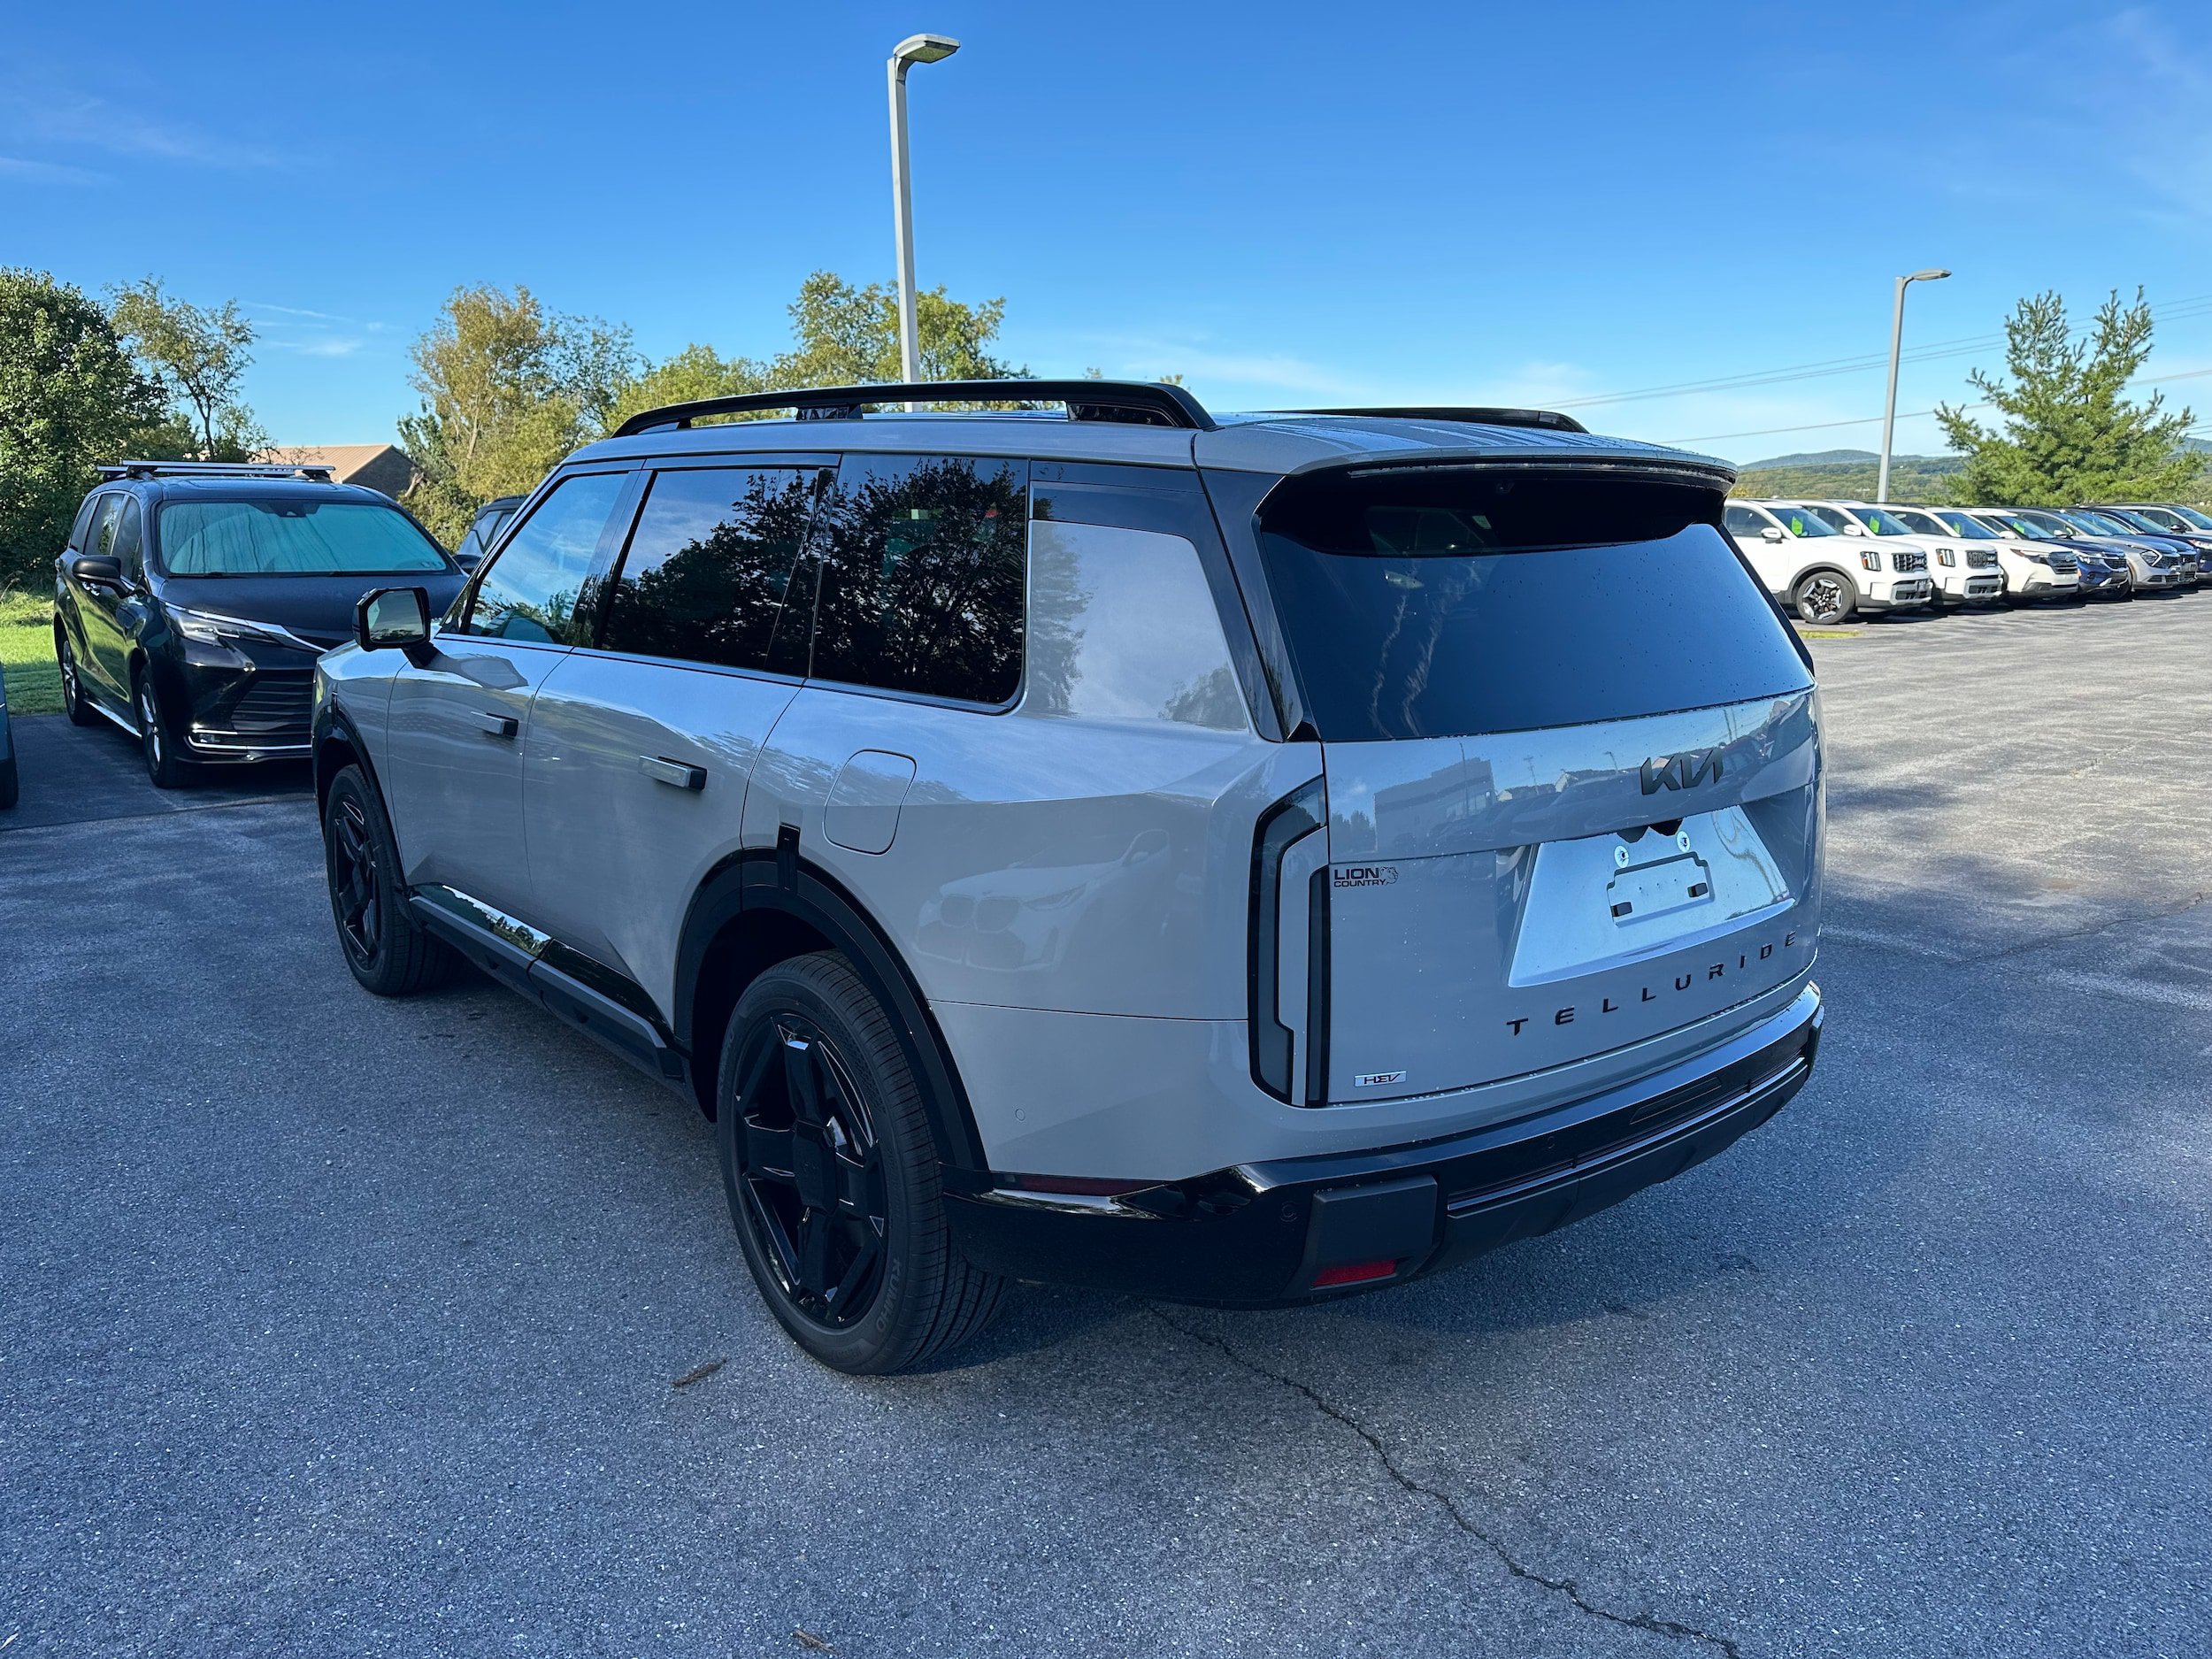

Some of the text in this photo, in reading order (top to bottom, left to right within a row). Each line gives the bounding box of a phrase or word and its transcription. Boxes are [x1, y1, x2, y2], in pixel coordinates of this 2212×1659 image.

[1334, 867, 1379, 879] LION
[1333, 879, 1386, 887] COUNTRY
[1506, 931, 1797, 1036] TELLURIDE
[1363, 1073, 1401, 1084] HEV
[876, 1256, 901, 1333] KUMHO
